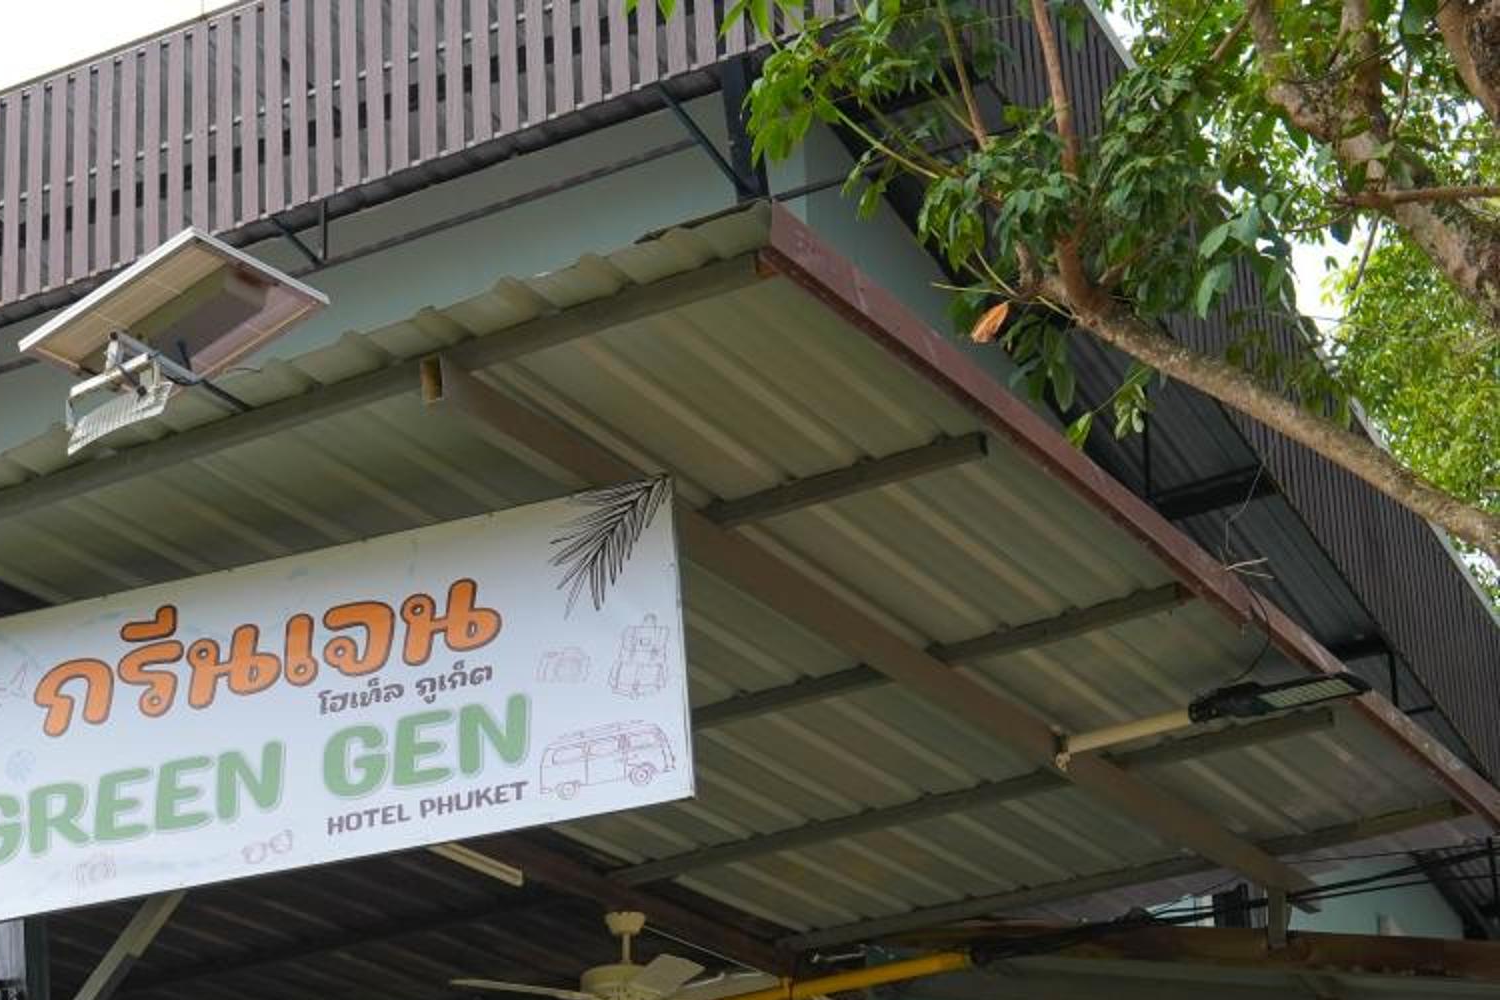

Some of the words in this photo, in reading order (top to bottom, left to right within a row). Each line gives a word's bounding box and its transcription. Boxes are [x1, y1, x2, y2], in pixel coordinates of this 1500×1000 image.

[33, 578, 502, 737] กรีนเจน
[317, 677, 405, 715] โฮเท็ล
[415, 659, 493, 704] ภูเก็ต
[321, 692, 532, 800] GEN
[327, 803, 411, 836] HOTEL
[419, 781, 528, 818] PHUKET
